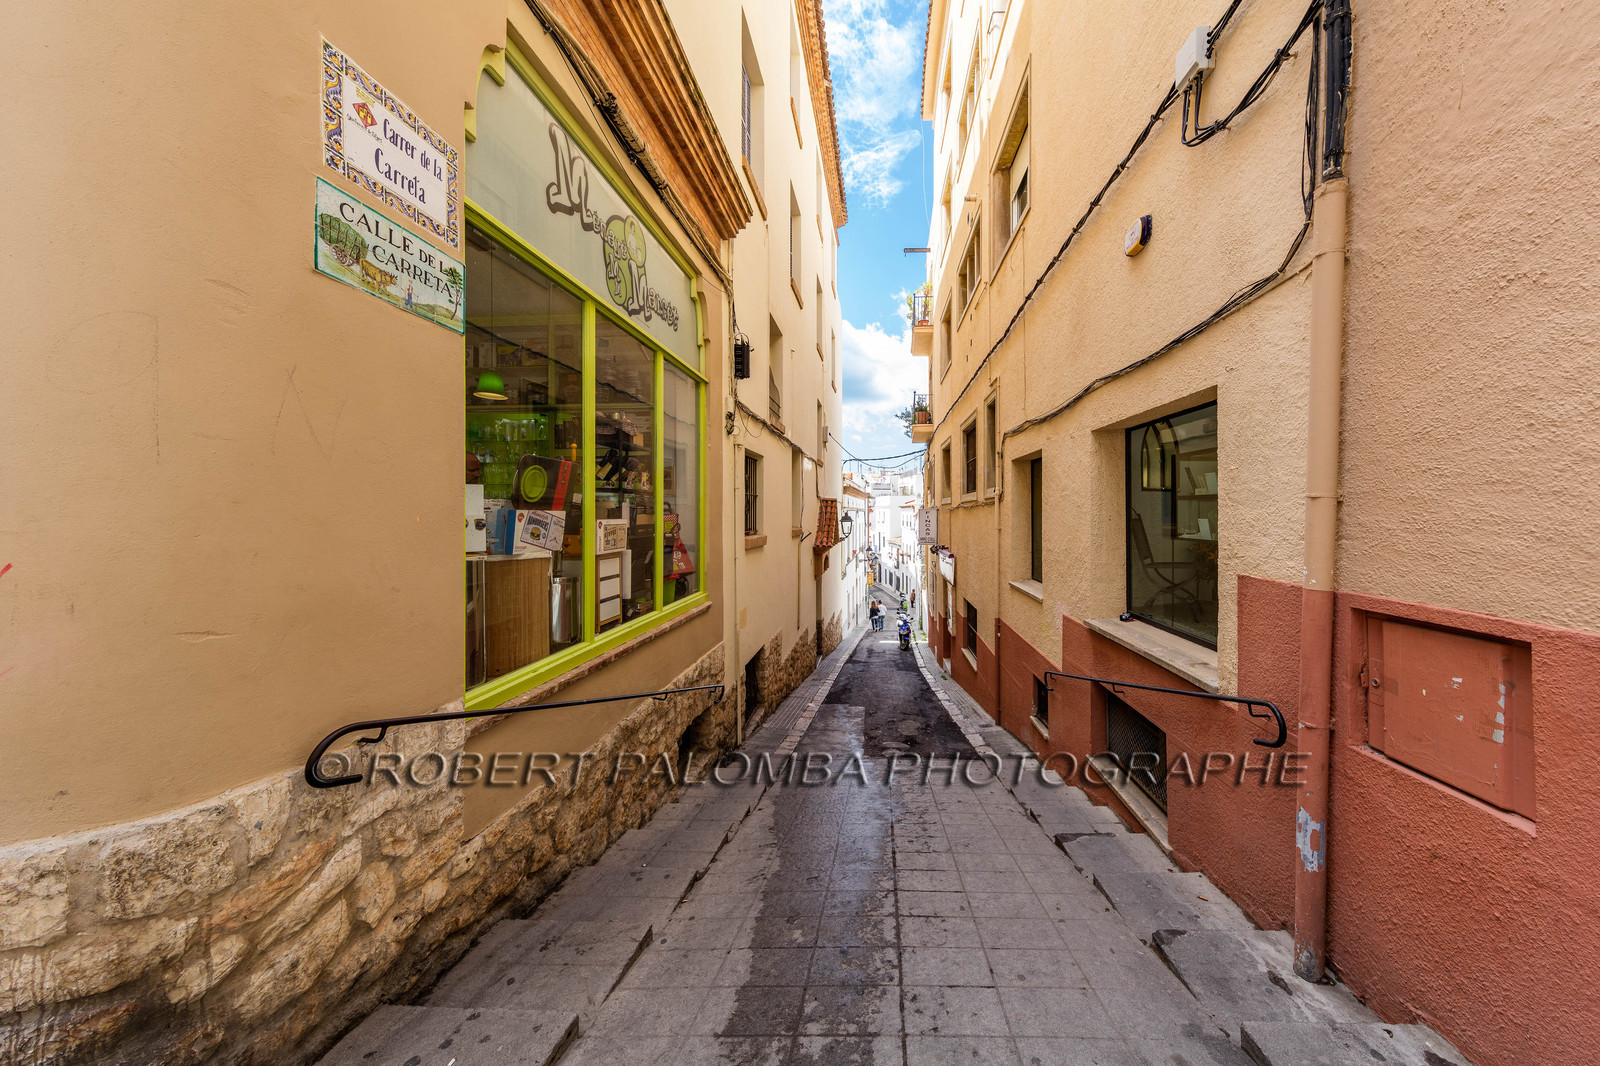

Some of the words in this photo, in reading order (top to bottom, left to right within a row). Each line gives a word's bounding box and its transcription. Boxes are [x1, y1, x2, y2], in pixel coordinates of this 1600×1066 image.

[374, 147, 426, 204] Carreta
[383, 118, 417, 159] Carrer
[420, 150, 431, 171] de
[433, 158, 442, 181] la
[339, 202, 414, 256] CALLE
[419, 248, 436, 269] DE
[439, 260, 457, 281] LA
[372, 244, 453, 298] CARRETA
